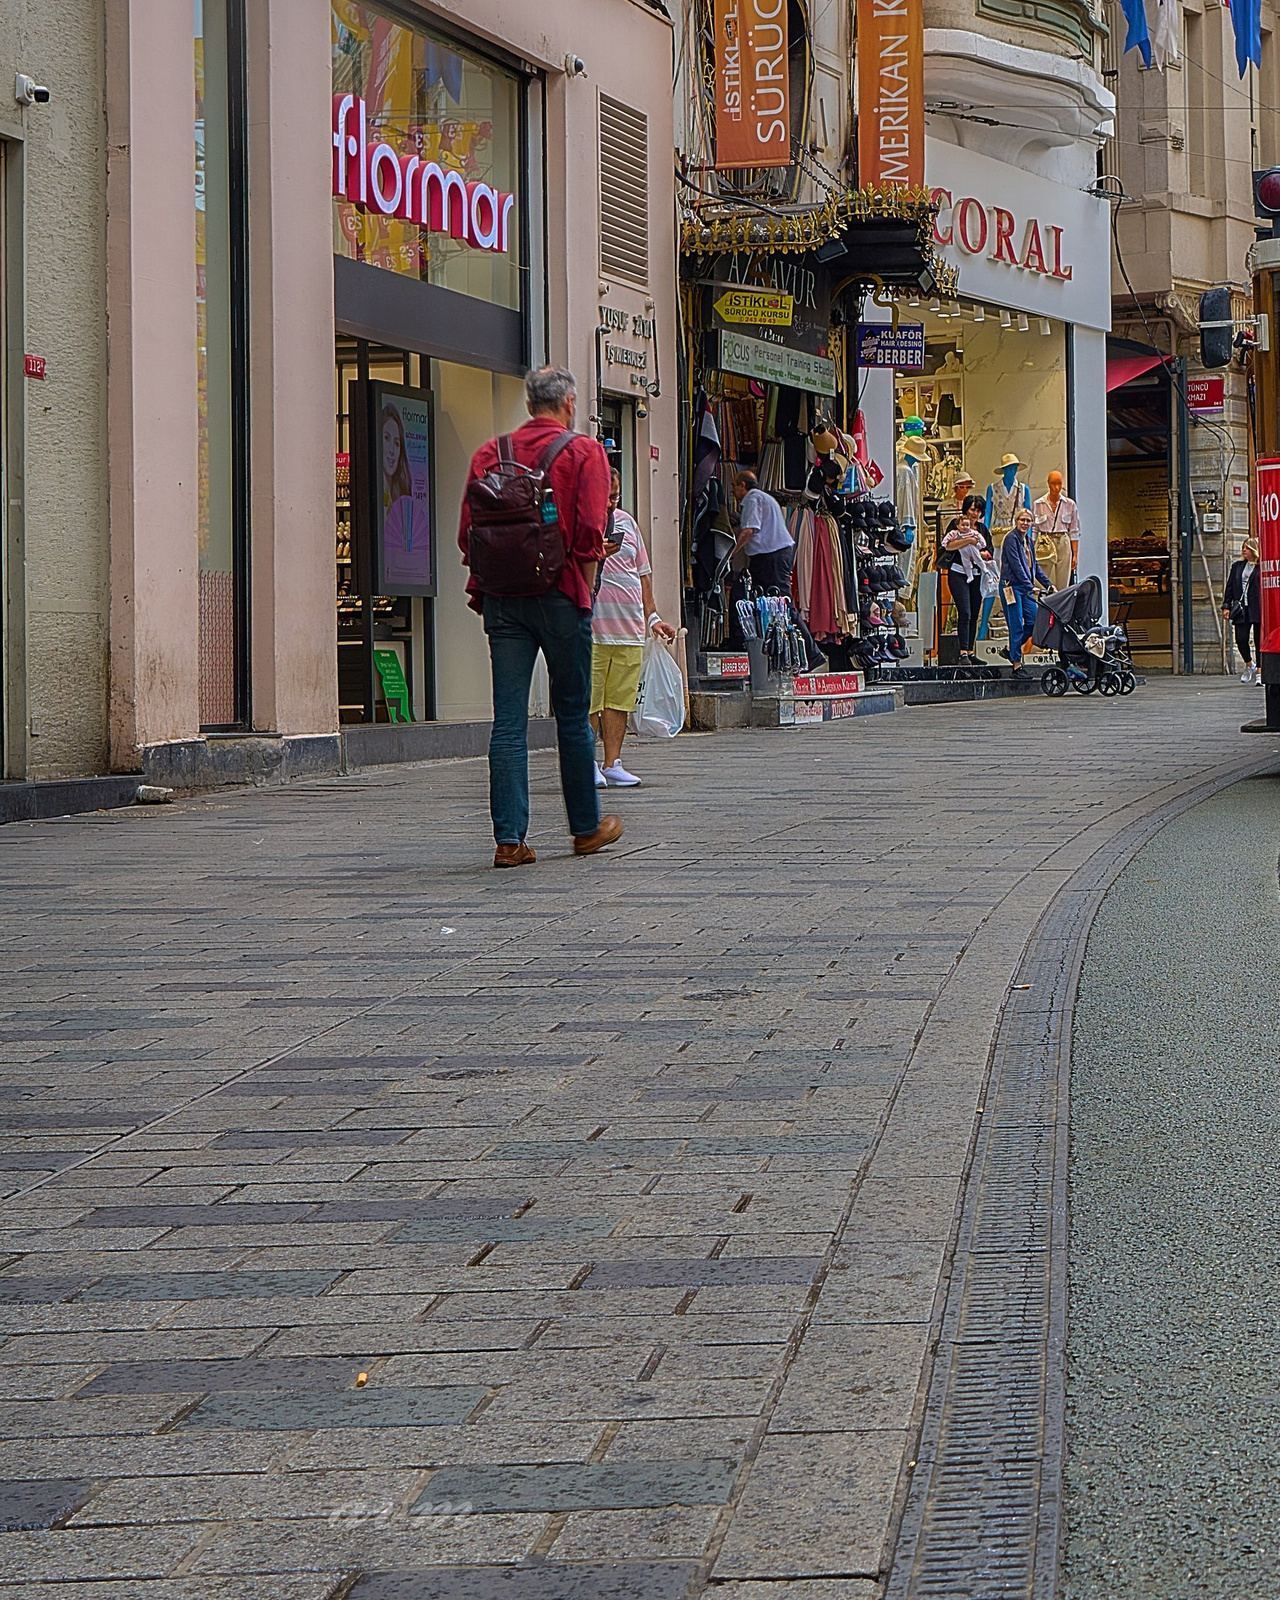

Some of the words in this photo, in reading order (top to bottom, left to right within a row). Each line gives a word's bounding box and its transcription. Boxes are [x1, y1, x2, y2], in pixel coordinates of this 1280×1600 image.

[722, 4, 741, 113] İSTİKLL
[873, 34, 909, 188] MERİKAN
[333, 92, 514, 254] flormar
[930, 187, 1072, 281] CORAL
[600, 305, 629, 332] YUSUF
[724, 307, 759, 317] SÜRÜCÜ
[760, 310, 790, 319] KURSU
[881, 329, 922, 340] KUAFÖR
[786, 353, 812, 373] Training
[814, 361, 835, 377] Studio
[877, 349, 921, 365] BERBER
[1188, 382, 1209, 392] TÜNCÜ
[402, 407, 427, 425] flormar
[1261, 493, 1279, 522] 410
[738, 661, 748, 672] SHOP
[1033, 655, 1060, 664] CORAL
